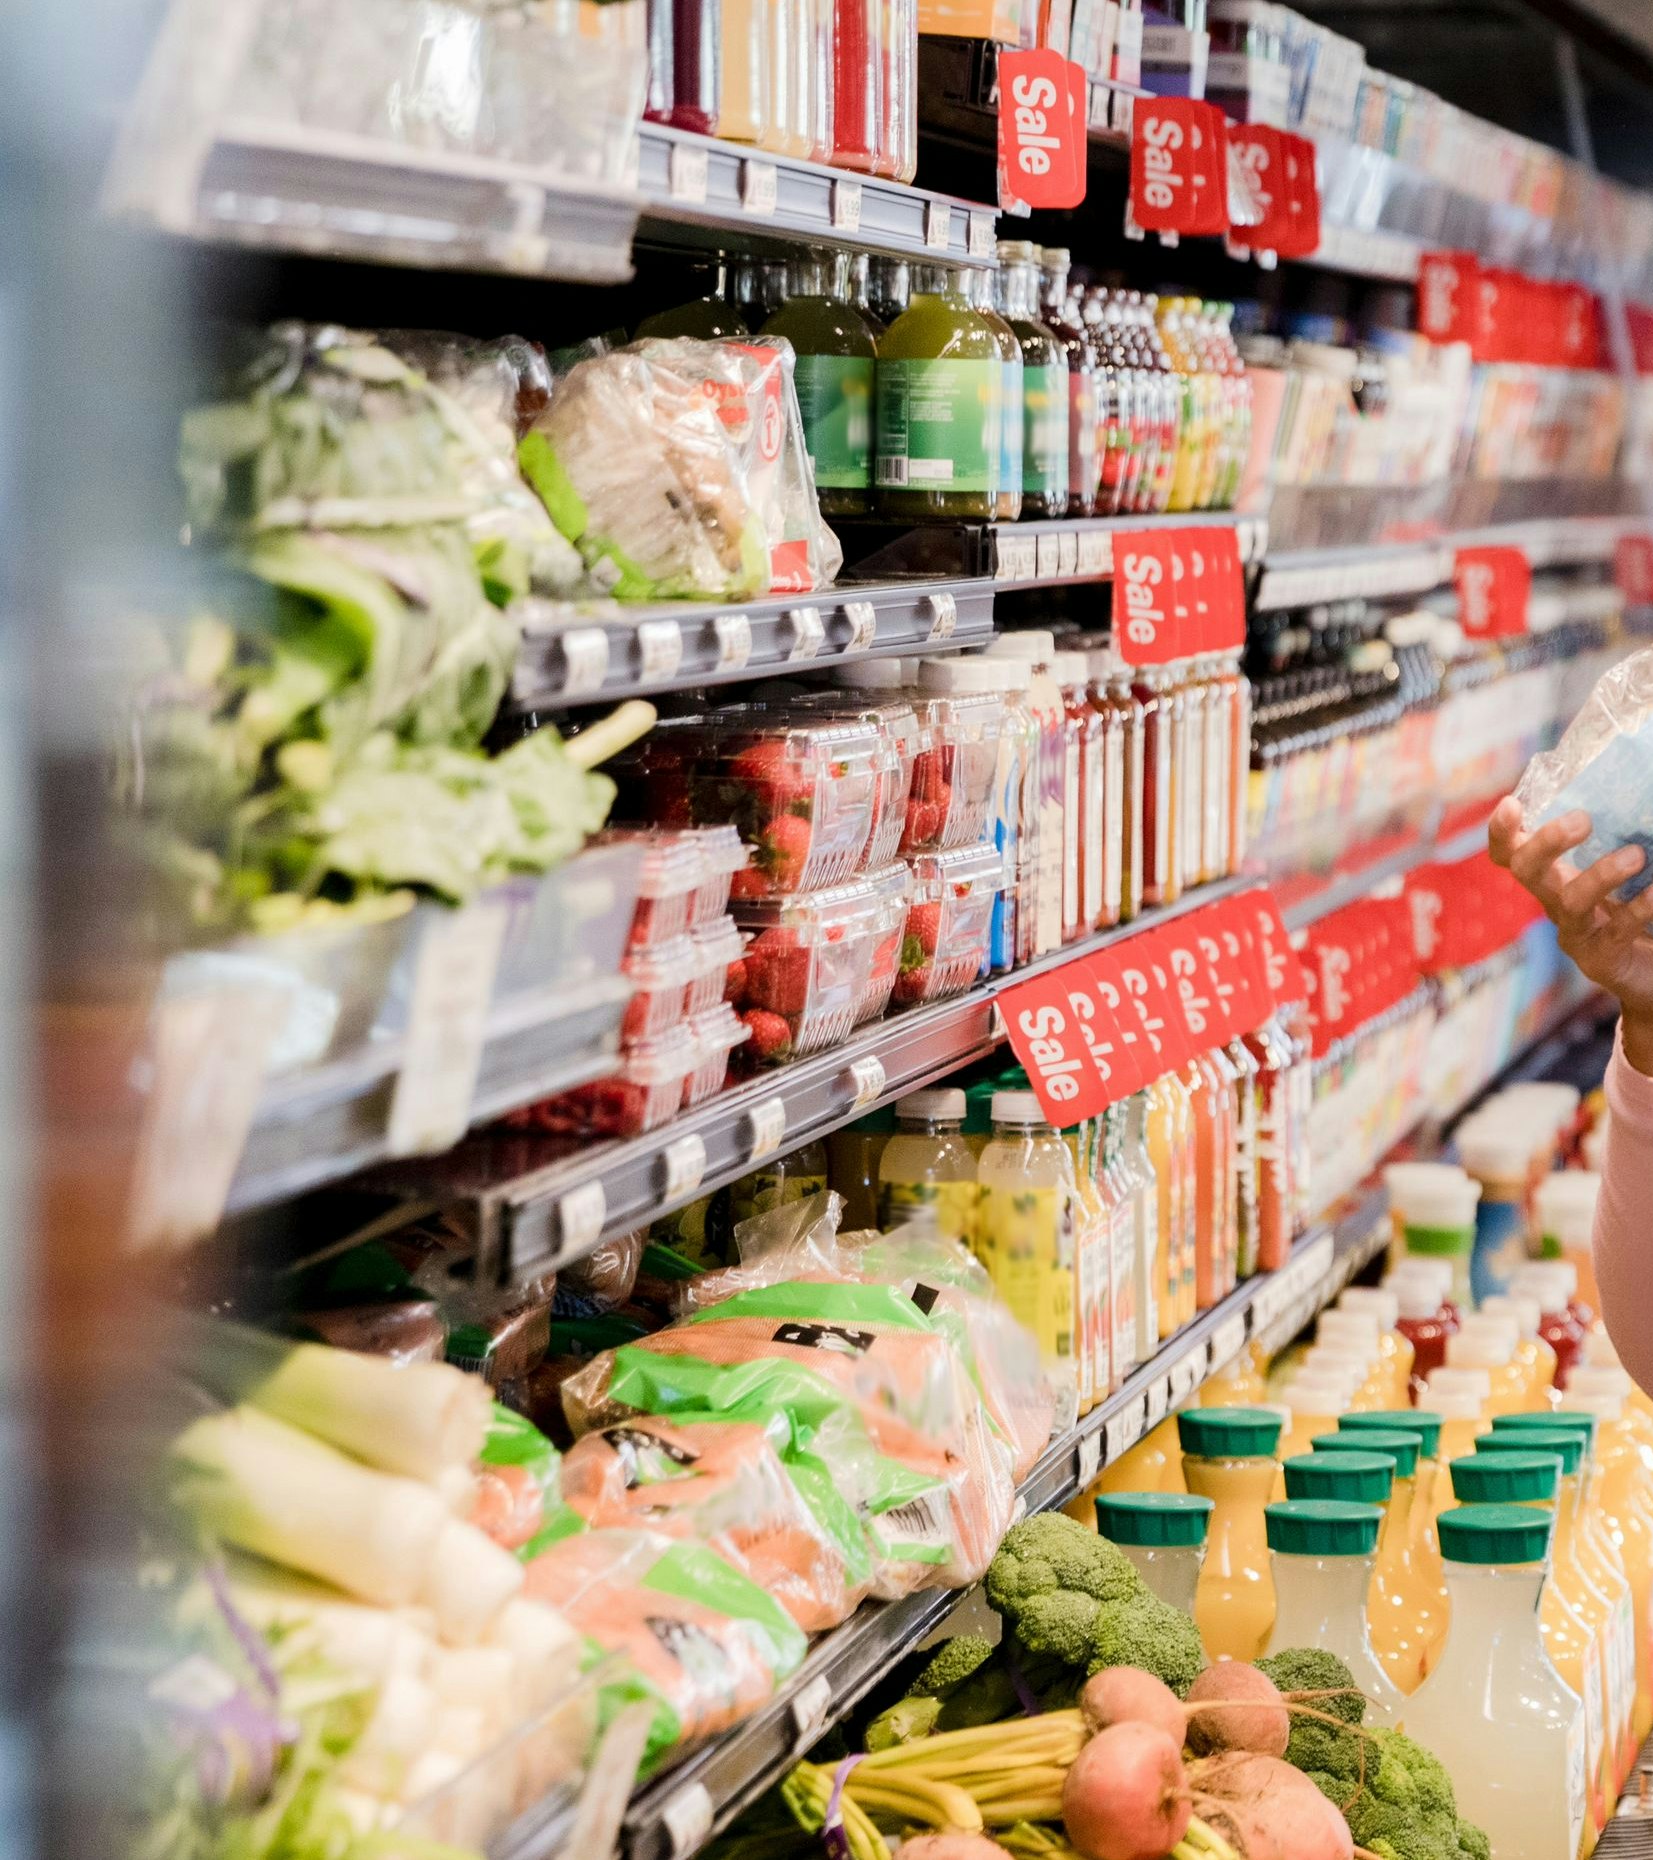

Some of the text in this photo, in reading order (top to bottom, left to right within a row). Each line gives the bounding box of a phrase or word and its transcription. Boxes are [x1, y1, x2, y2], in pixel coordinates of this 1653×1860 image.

[1012, 74, 1060, 175] Sale
[1143, 116, 1183, 209] Sale
[1124, 554, 1165, 644] Sale
[1018, 1005, 1083, 1101] Sale
